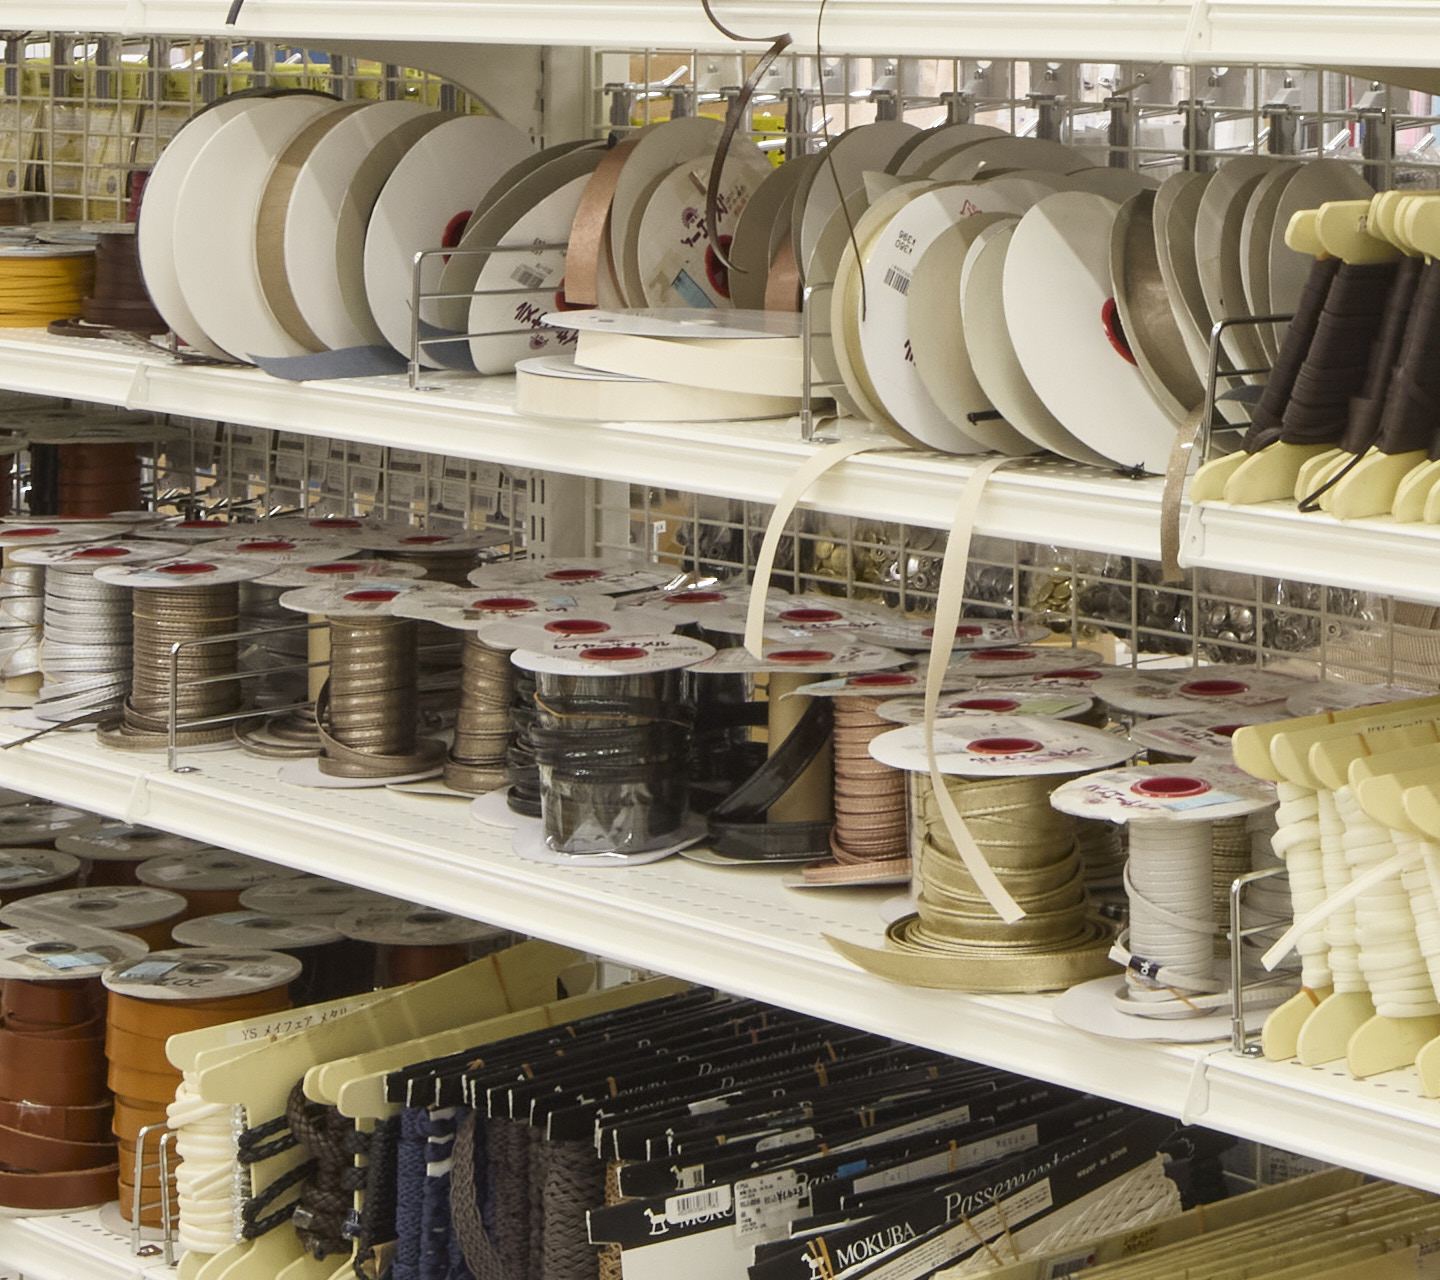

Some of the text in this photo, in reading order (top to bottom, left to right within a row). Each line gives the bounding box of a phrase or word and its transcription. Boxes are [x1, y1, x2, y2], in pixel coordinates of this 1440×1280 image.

[241, 1028, 258, 1040] YS
[264, 1015, 313, 1036] メイフェア
[680, 1203, 734, 1228] MOKU
[836, 1221, 916, 1269] MOKUBA
